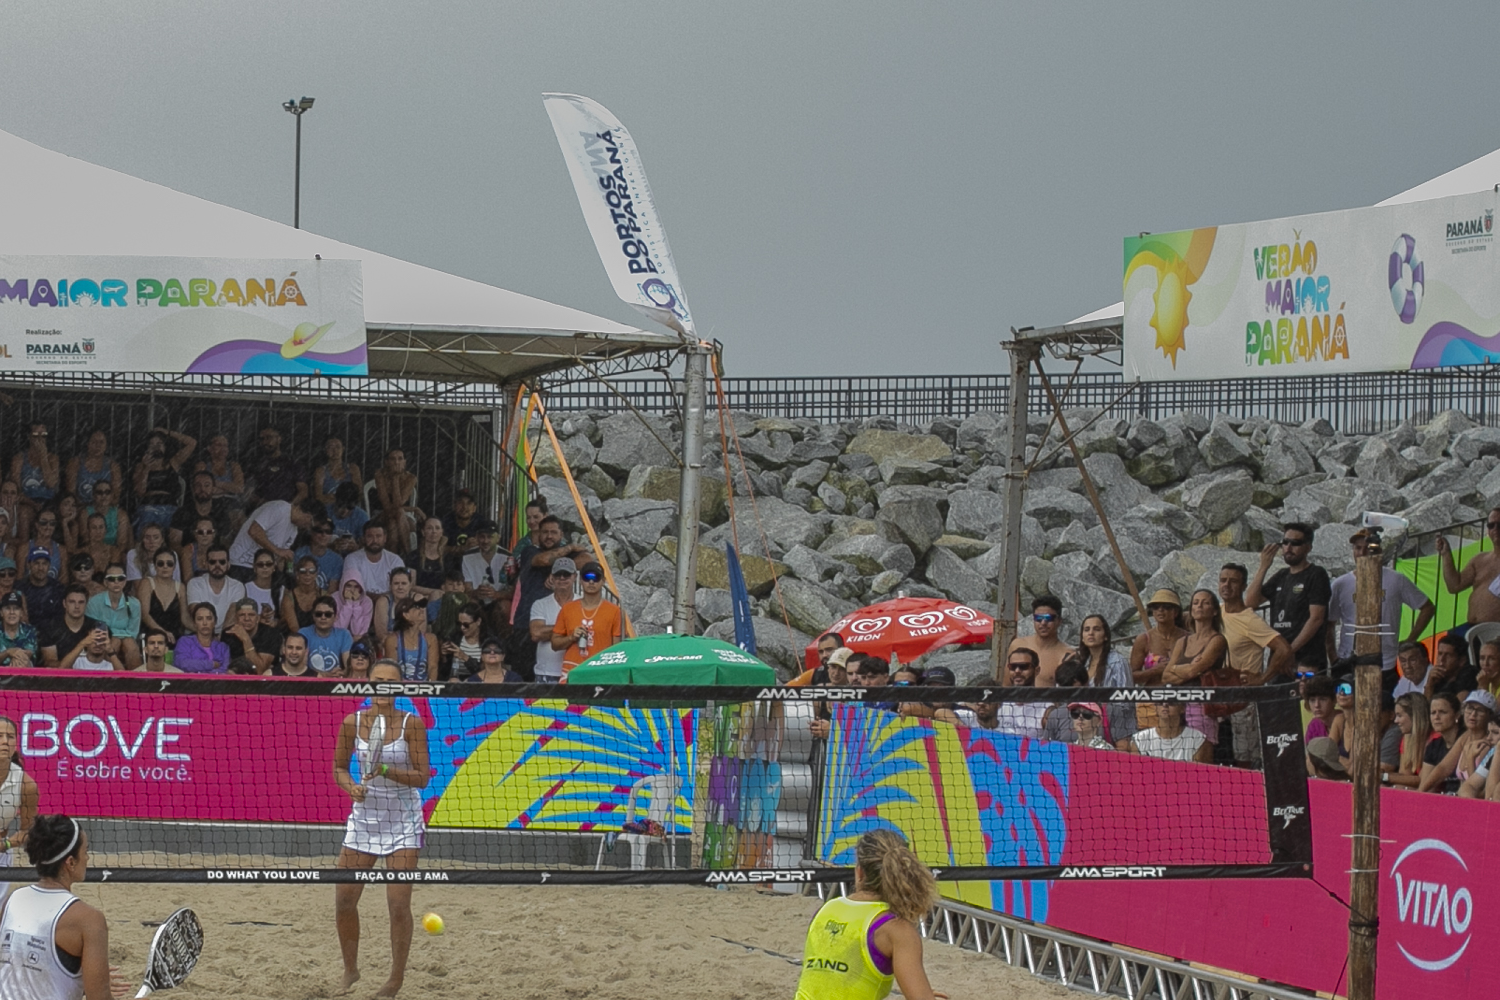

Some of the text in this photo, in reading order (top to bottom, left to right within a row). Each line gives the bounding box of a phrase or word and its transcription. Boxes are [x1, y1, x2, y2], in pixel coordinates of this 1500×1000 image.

[596, 130, 643, 233] PARANÁ
[600, 174, 648, 274] PORTOS
[1446, 216, 1484, 238] PARANÁ
[1254, 229, 1318, 281] VERÃO
[136, 271, 308, 308] PARANÁ
[1265, 275, 1330, 315] MAIOR
[1246, 302, 1350, 366] PARANÁ
[26, 342, 81, 354] PARANÁ
[846, 633, 882, 643] KIBON
[909, 625, 948, 637] KIBON
[57, 760, 192, 782] É sobre você.
[207, 871, 320, 880] DO WHAT YOU LOVE
[355, 872, 449, 882] FAÇA O QUE AMA
[1395, 871, 1473, 935] VITAO
[806, 957, 849, 973] ZAND
